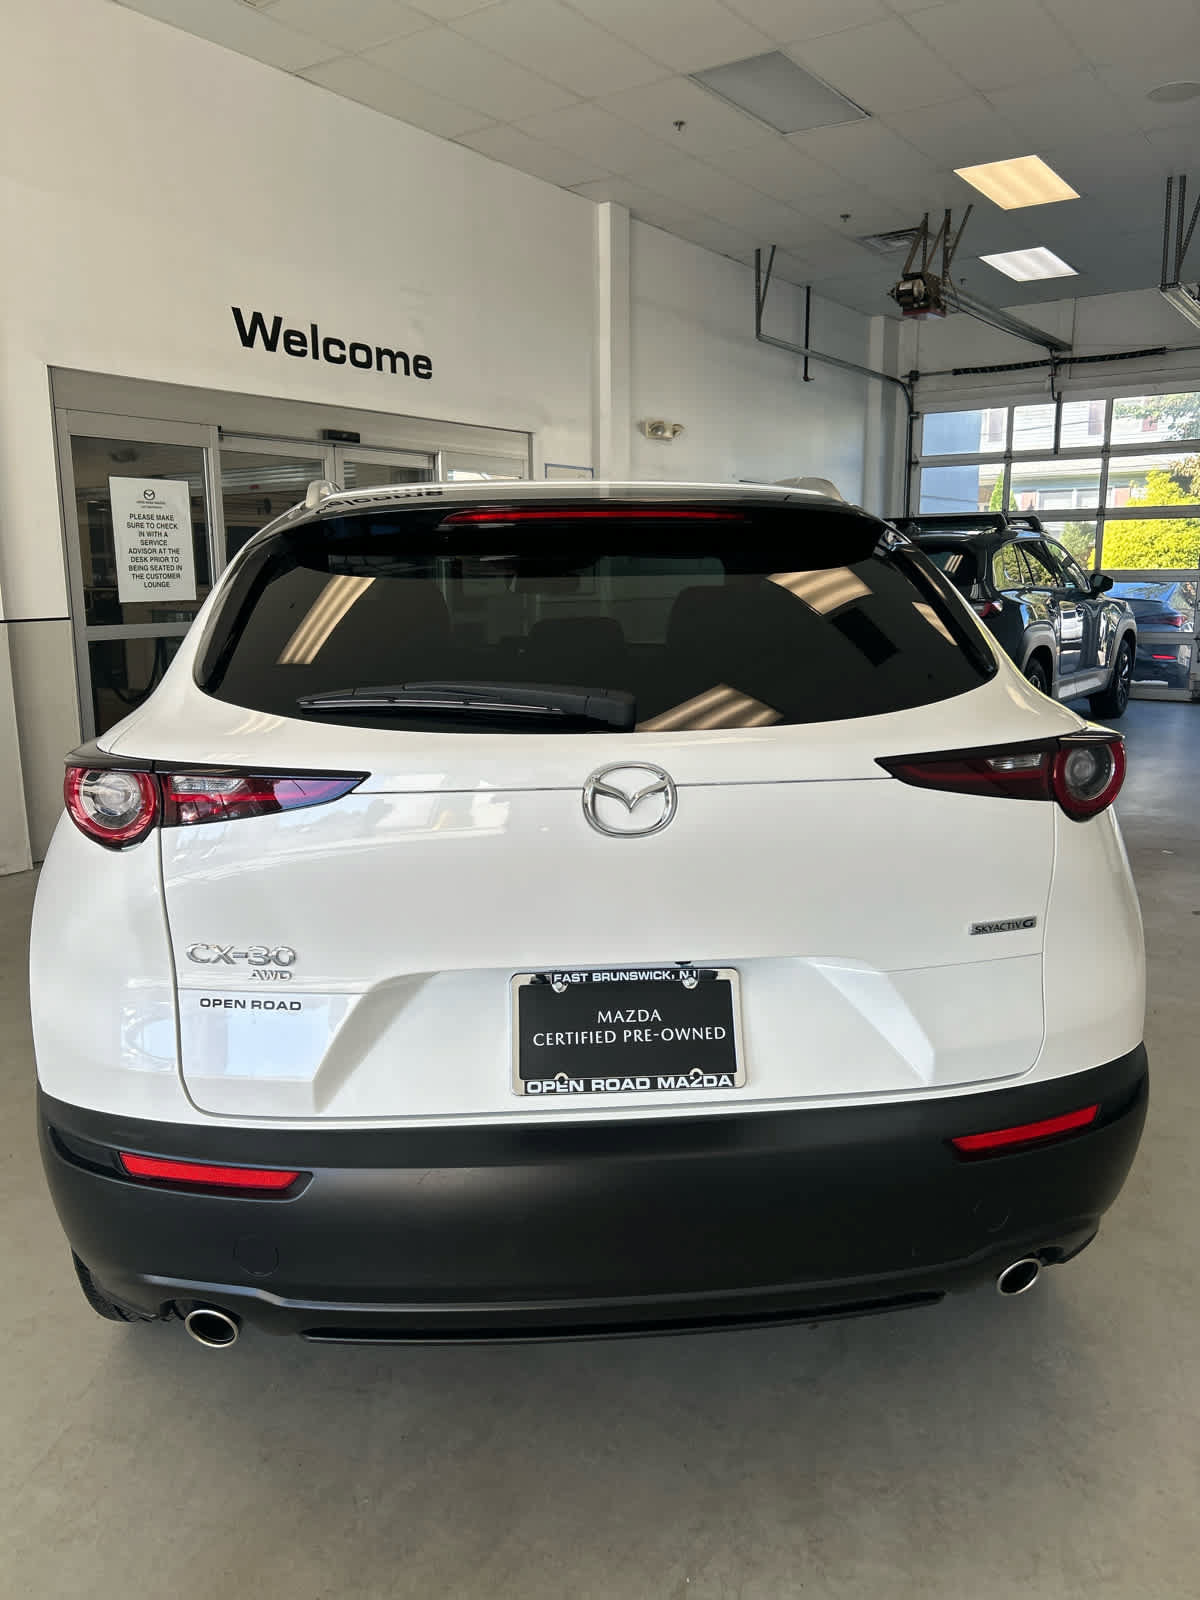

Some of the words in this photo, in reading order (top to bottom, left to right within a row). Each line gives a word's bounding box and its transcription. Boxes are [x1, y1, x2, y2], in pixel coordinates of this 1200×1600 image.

[231, 306, 433, 380] Welcome
[129, 513, 154, 521] PLEASE
[140, 539, 167, 547] SERVICE
[128, 547, 157, 555] ADVISOR
[186, 943, 296, 967] CX-30
[248, 969, 293, 981] AWD
[592, 970, 675, 982] BRUNSWICK,
[199, 998, 246, 1009] OPEN
[250, 1000, 302, 1011] ROAD
[597, 1008, 662, 1024] MAZDA
[532, 1029, 617, 1046] CERTIFIED
[623, 1026, 726, 1043] PRE-OWNED
[526, 1079, 584, 1094] OPEN
[591, 1078, 651, 1092] ROAD
[657, 1074, 733, 1089] MAZDA
